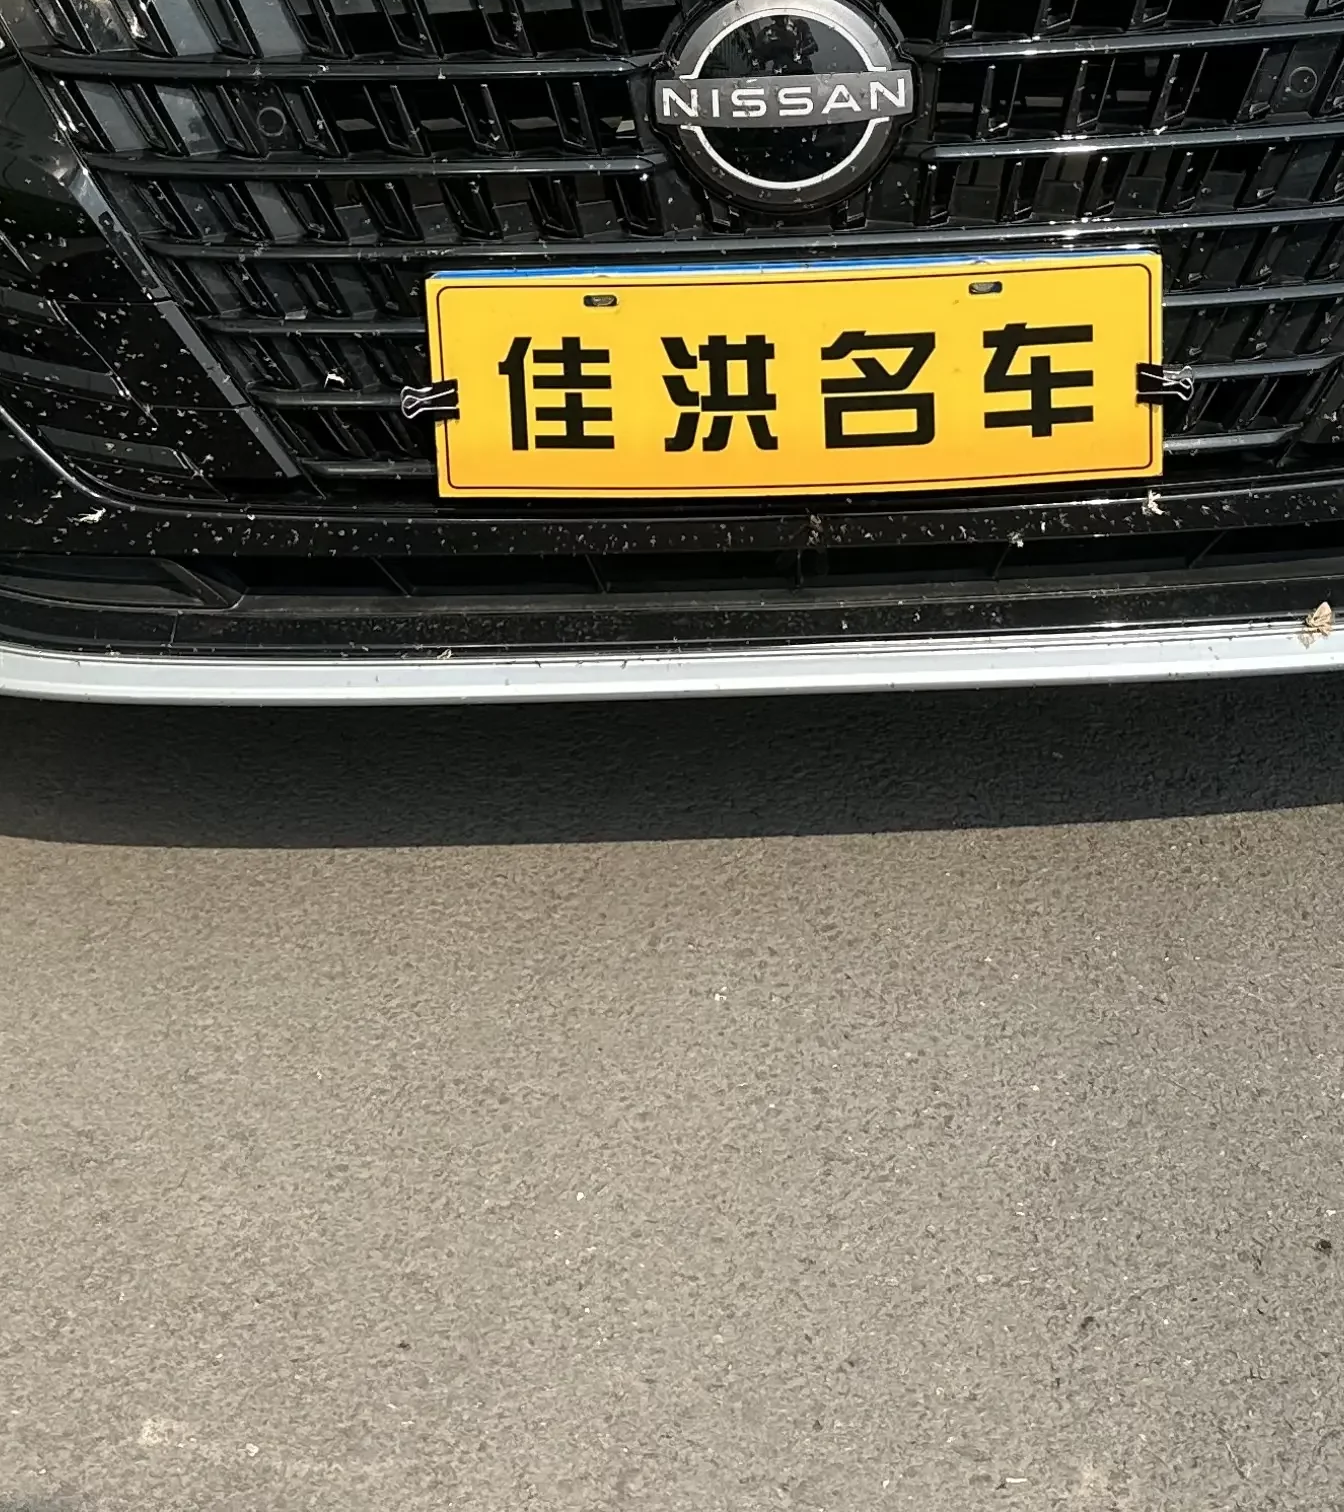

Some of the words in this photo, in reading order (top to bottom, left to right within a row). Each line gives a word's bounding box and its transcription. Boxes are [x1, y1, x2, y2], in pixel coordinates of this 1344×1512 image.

[661, 78, 906, 118] NISSAN
[498, 322, 1094, 452] 佳洪名车
